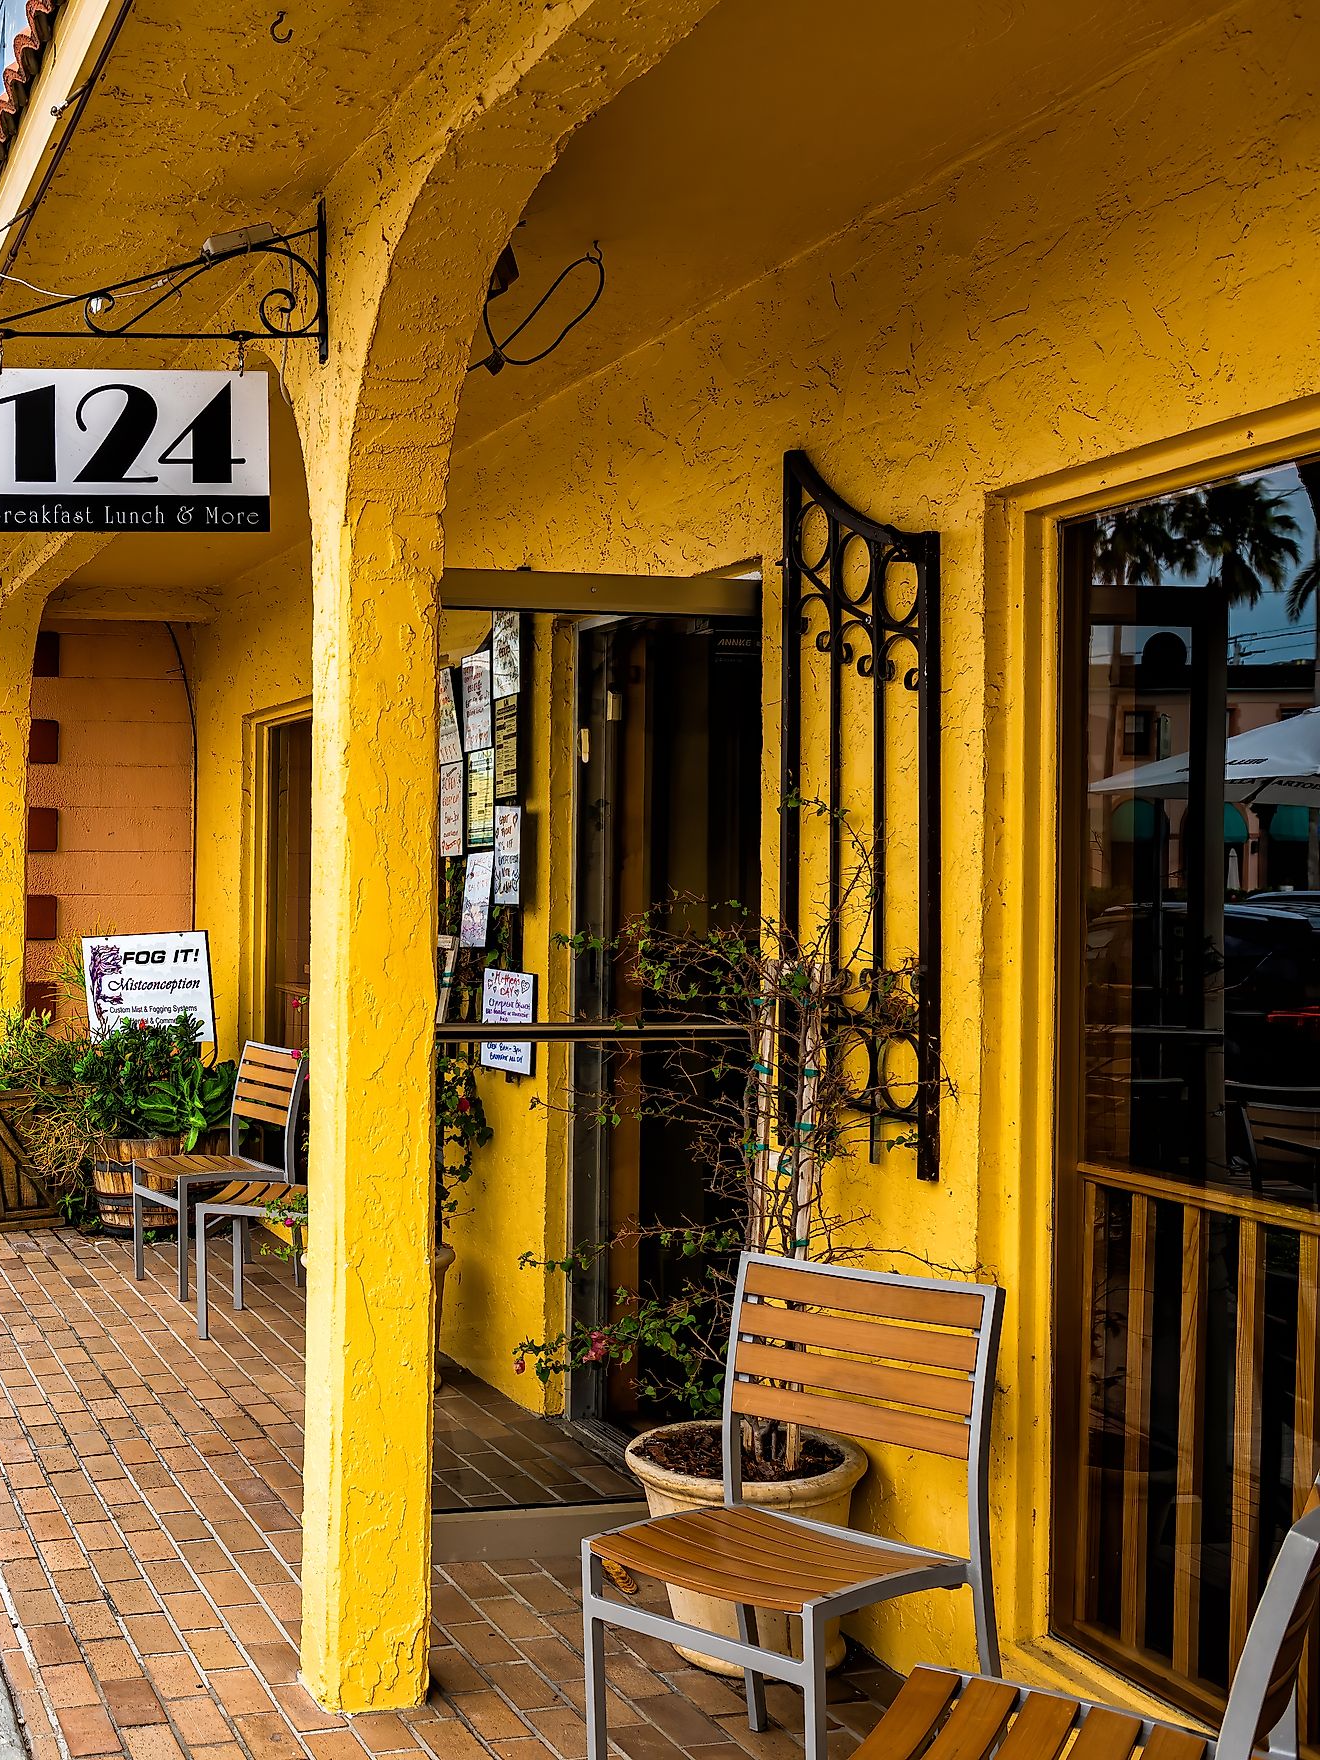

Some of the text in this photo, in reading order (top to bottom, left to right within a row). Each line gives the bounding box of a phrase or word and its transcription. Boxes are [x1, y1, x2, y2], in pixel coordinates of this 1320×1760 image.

[105, 505, 165, 525] Lunch
[176, 506, 195, 525] &
[205, 506, 260, 525] More
[122, 948, 199, 965] FOG IT!
[108, 977, 201, 995] Mistconception
[149, 1005, 172, 1014] Fogging
[172, 1005, 198, 1013] Systems
